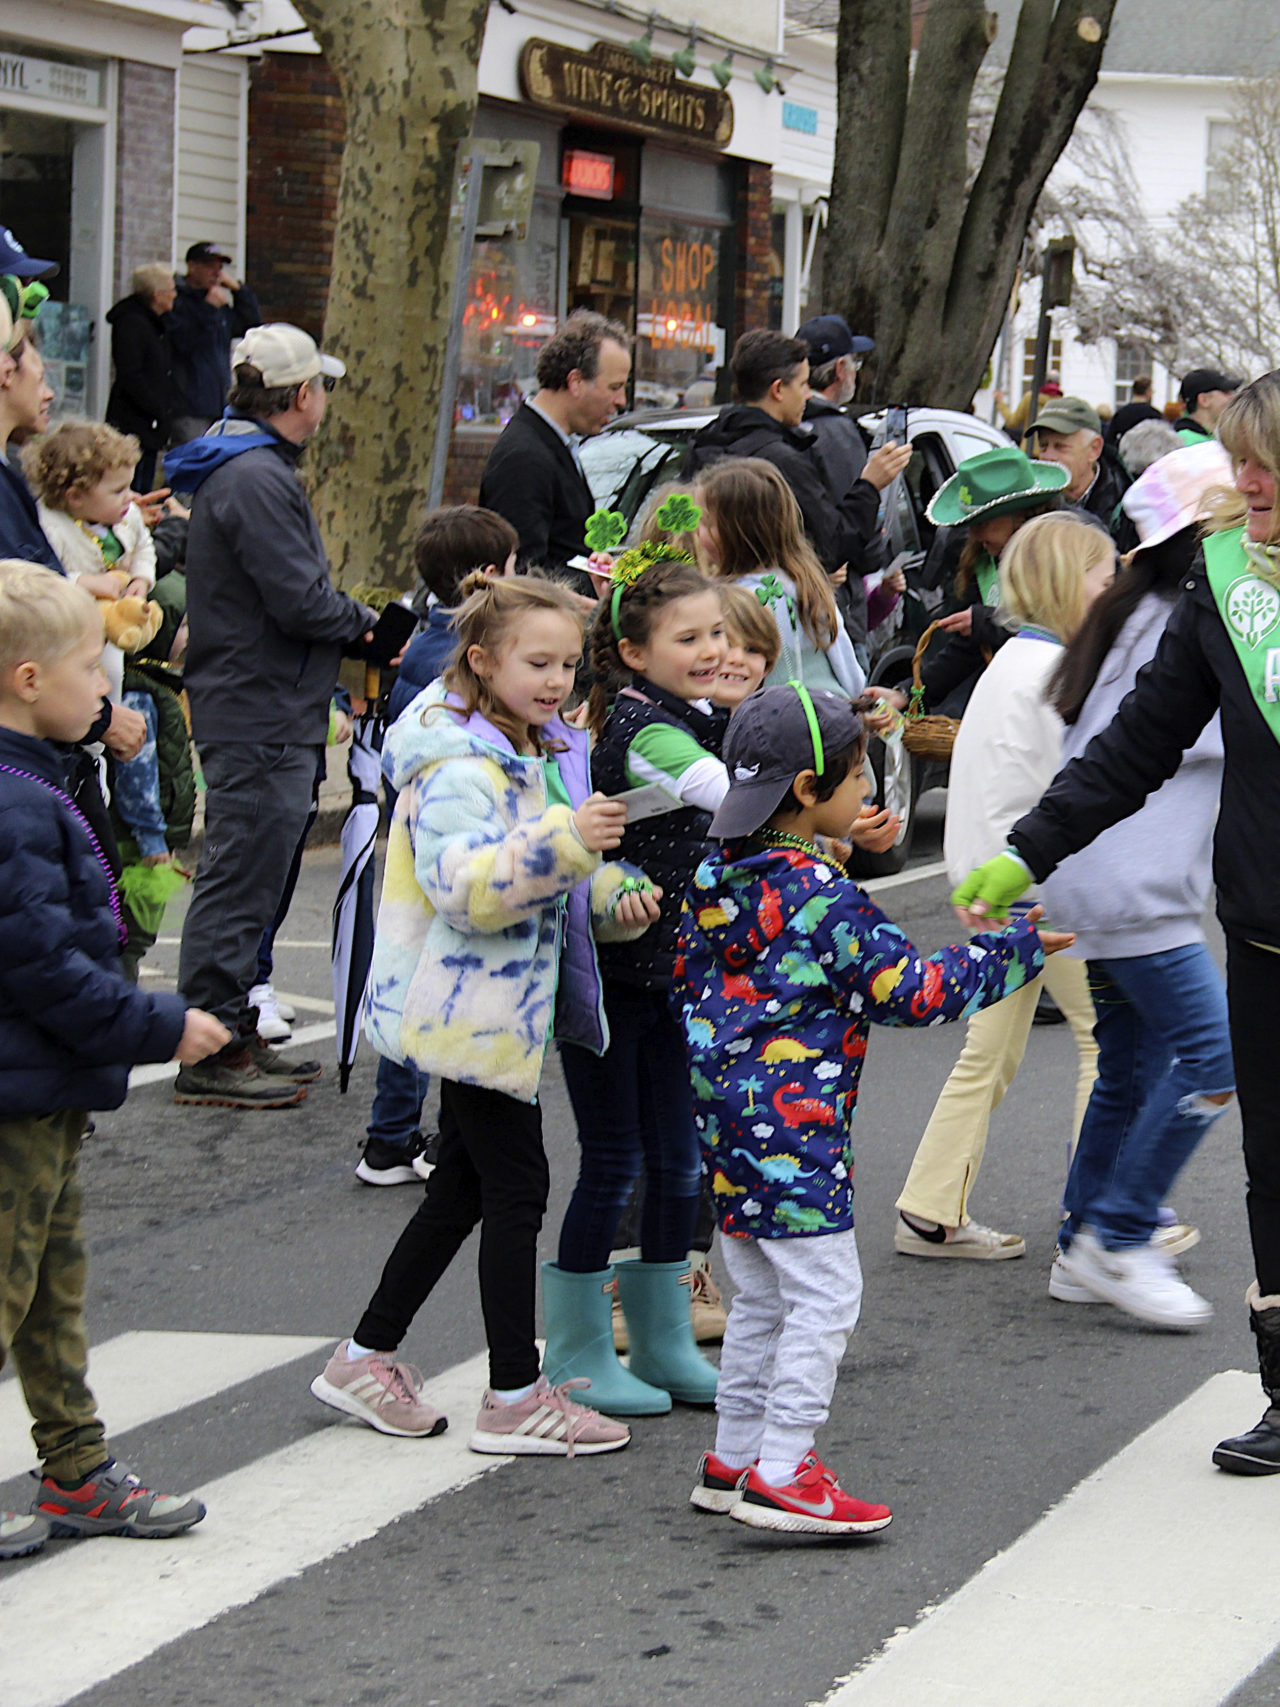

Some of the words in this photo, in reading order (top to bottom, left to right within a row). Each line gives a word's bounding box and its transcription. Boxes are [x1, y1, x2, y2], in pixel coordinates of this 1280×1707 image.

[563, 61, 614, 107] WINE
[639, 82, 706, 130] SPIRITS
[661, 238, 715, 293] SHOP
[649, 298, 716, 355] LOCAL
